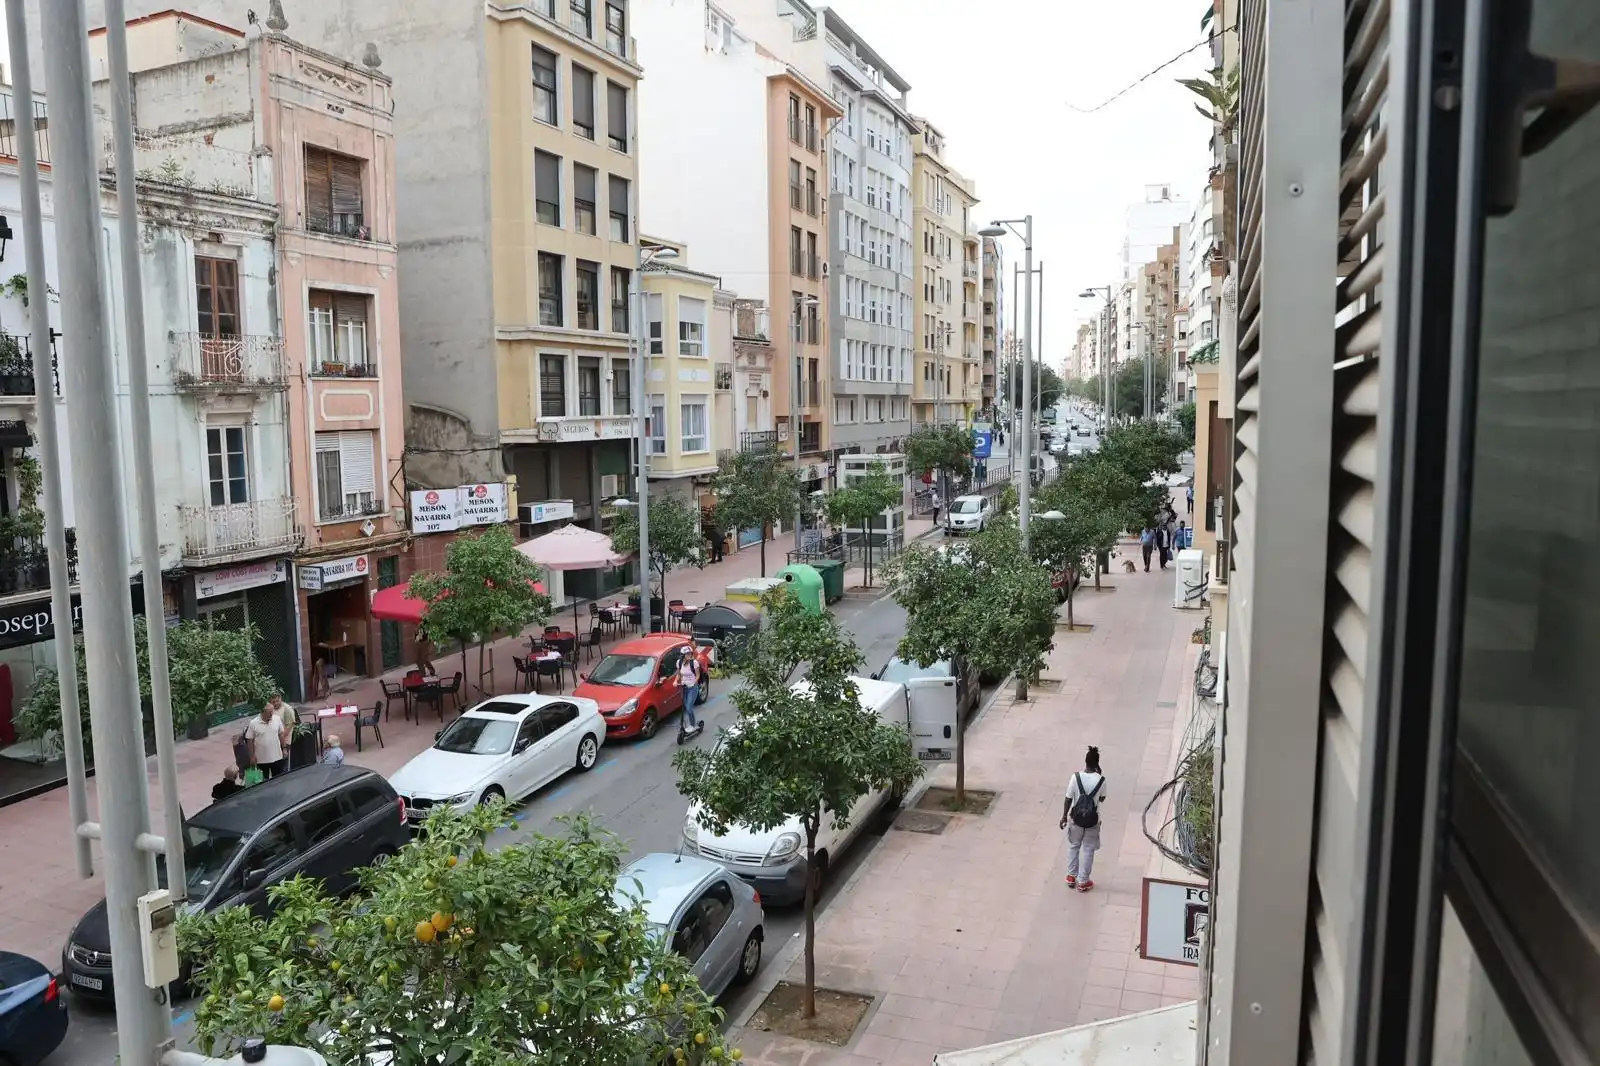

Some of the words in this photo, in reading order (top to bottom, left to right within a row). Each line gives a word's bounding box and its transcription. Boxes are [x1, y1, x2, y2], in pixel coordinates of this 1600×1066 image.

[564, 425, 590, 433] SEGUROS
[468, 498, 495, 506] MESON
[418, 504, 447, 512] MESON
[464, 506, 499, 515] NAVARRA
[414, 513, 452, 522] NAVARRA
[427, 523, 440, 531] 107
[215, 571, 230, 581] LOW
[232, 567, 247, 577] COST
[1183, 946, 1200, 960] TRA
